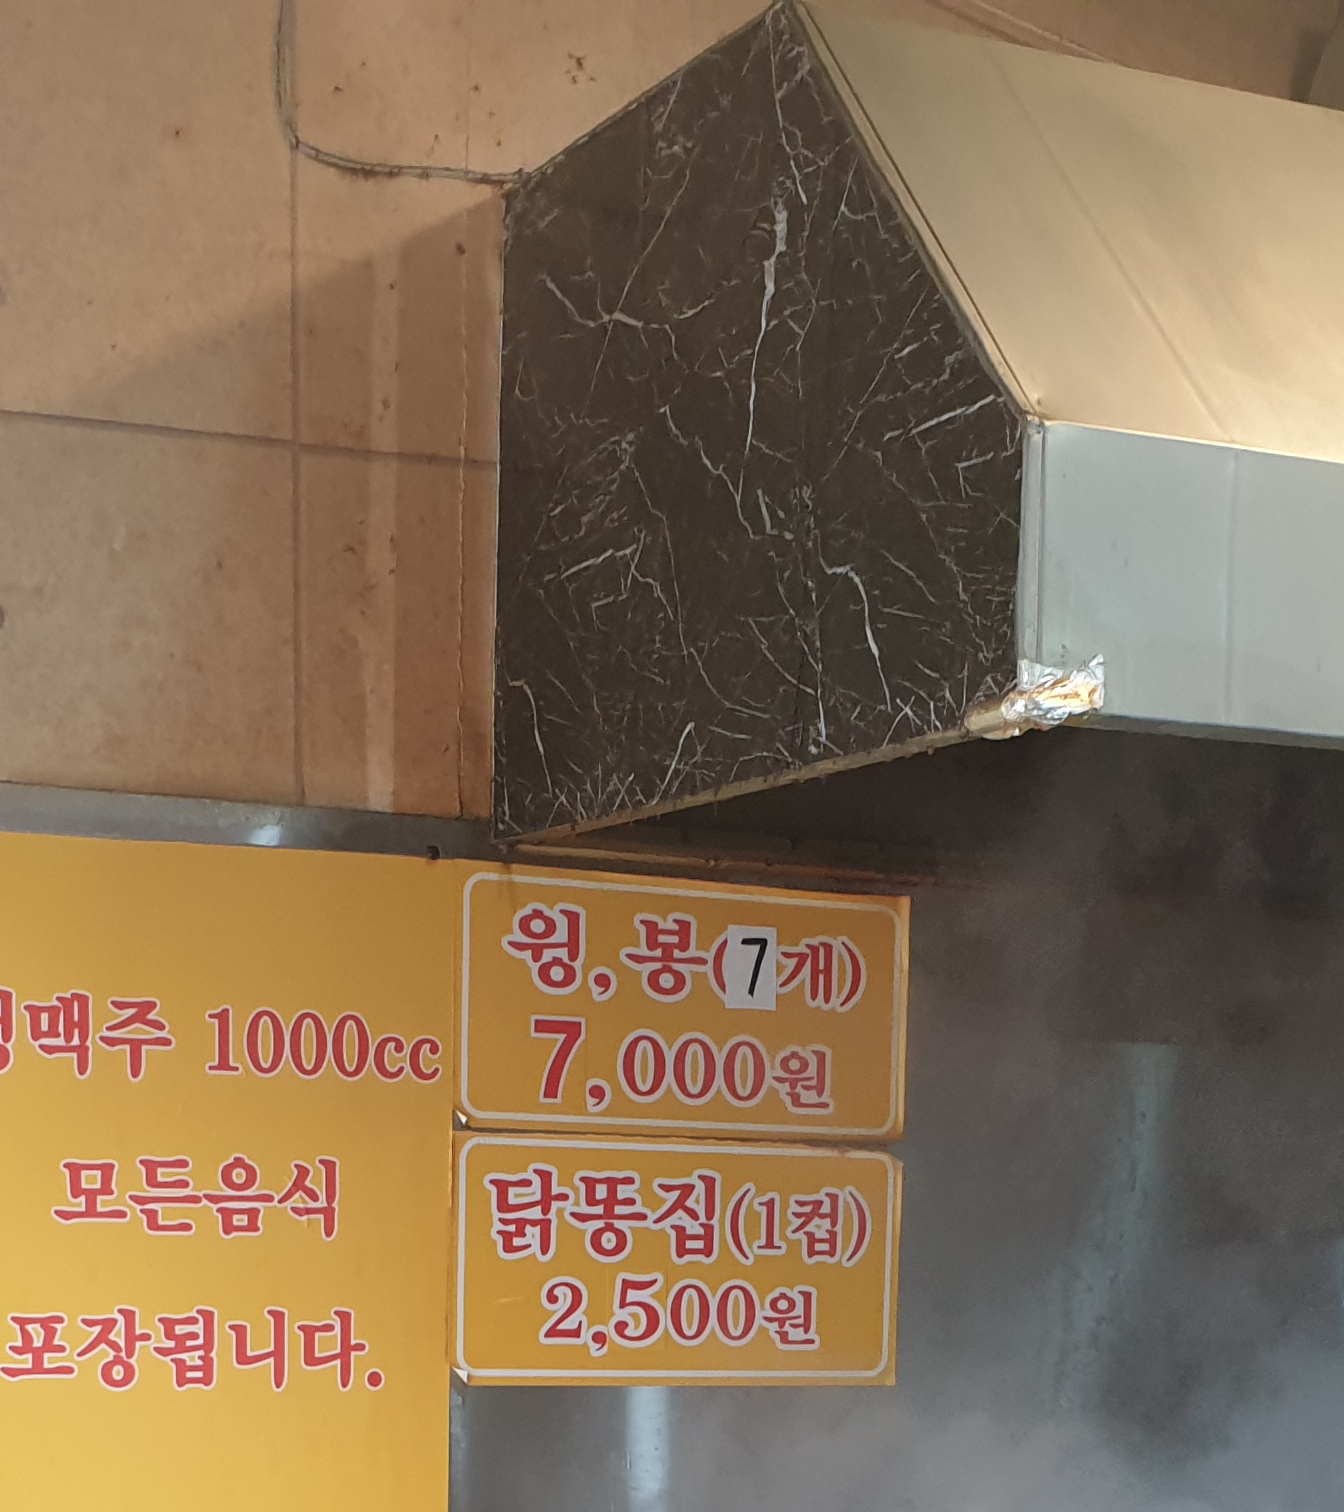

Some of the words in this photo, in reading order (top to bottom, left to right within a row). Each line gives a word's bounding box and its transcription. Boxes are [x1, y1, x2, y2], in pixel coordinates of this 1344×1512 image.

[206, 1006, 444, 1082] 1000cc
[531, 1015, 834, 1113] 7,000원
[53, 1156, 340, 1239] 모든음식
[540, 1273, 818, 1355] 2,500원
